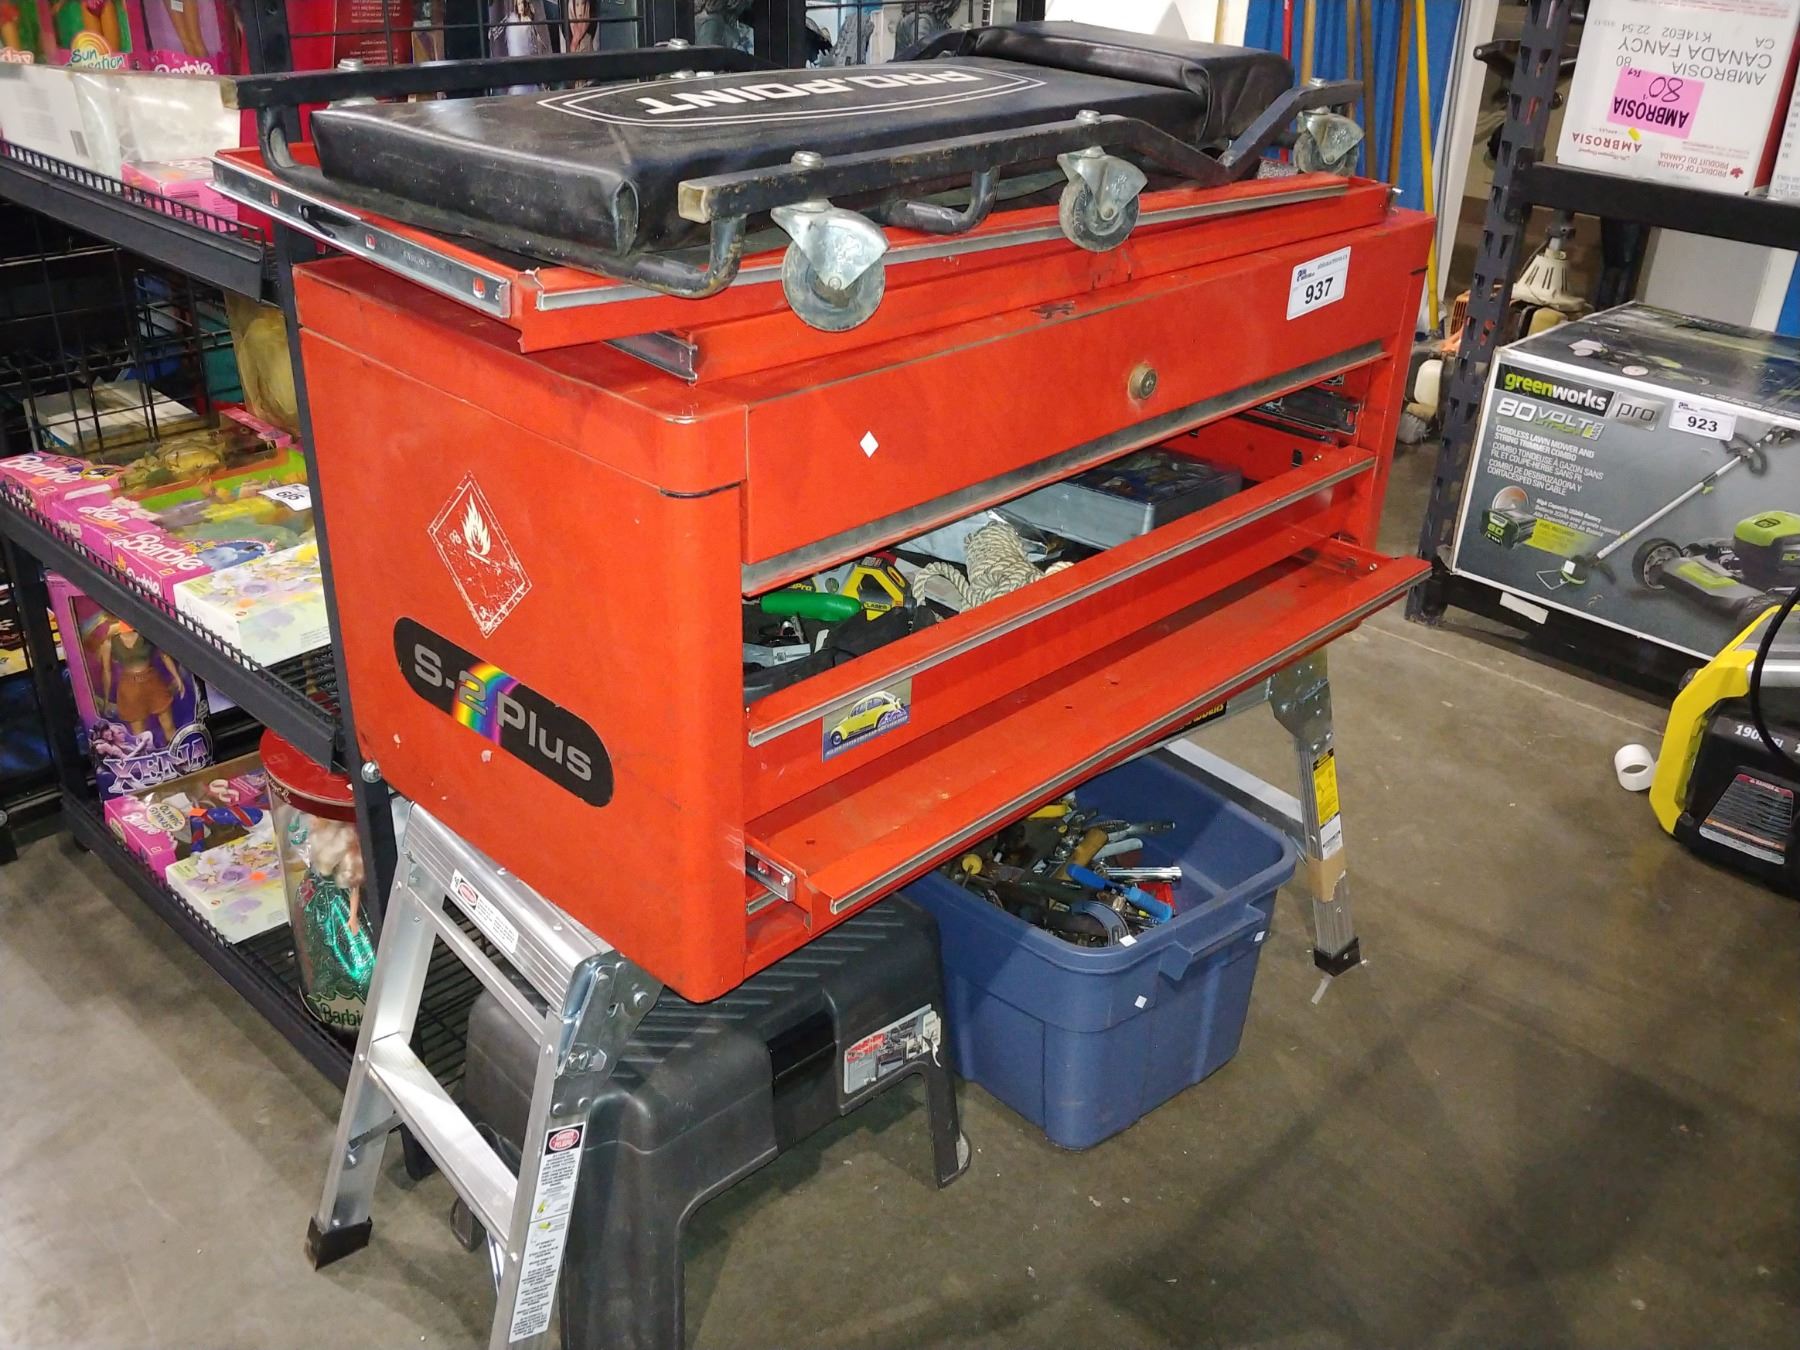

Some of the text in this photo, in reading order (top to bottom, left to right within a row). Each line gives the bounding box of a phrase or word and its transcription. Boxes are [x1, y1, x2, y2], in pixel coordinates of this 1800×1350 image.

[1621, 23, 1651, 34] 22.54
[1662, 26, 1712, 43] K14E02
[71, 49, 97, 63] Sun
[1618, 36, 1772, 69] CANADA FANCY
[1755, 37, 1775, 49] CA
[1672, 61, 1767, 86] AMBROSIA
[1613, 96, 1689, 128] AMBROSIA
[1572, 132, 1641, 153] AMBROSIA
[1657, 160, 1727, 178] PRODUCT OF CANADA
[1660, 152, 1685, 163] CANADA
[1699, 157, 1729, 169] PRODUIT
[1305, 277, 1334, 304] 937
[1504, 372, 1607, 411] greenworks
[1615, 402, 1655, 422] pro
[1496, 397, 1593, 428] 80 VOLT
[1687, 414, 1719, 433] 923
[1494, 433, 1577, 462] STRING TRIMMER COMBO
[1495, 425, 1595, 459] CORDLESS LAWN MOWER AND
[0, 455, 81, 484] Barbie
[1492, 442, 1518, 455] COMBO
[1518, 448, 1553, 465] TONDEUSE
[1559, 460, 1583, 473] GAZON
[1583, 468, 1604, 480] SANS
[1500, 451, 1509, 460] ET
[1509, 454, 1554, 474] COUPE-HERBE
[1555, 468, 1574, 480] SANS
[1488, 459, 1514, 472] COMBO
[1513, 465, 1522, 474] DE
[1523, 468, 1577, 491] DESBROZADORA
[1532, 478, 1544, 489] SIN
[1544, 484, 1567, 496] CABLE
[78, 506, 130, 522] Ken
[113, 533, 204, 571] Barbie
[497, 691, 592, 782] Plus
[1734, 724, 1763, 743] 190
[103, 737, 206, 796] XENA
[320, 1002, 363, 1027] Barbi
